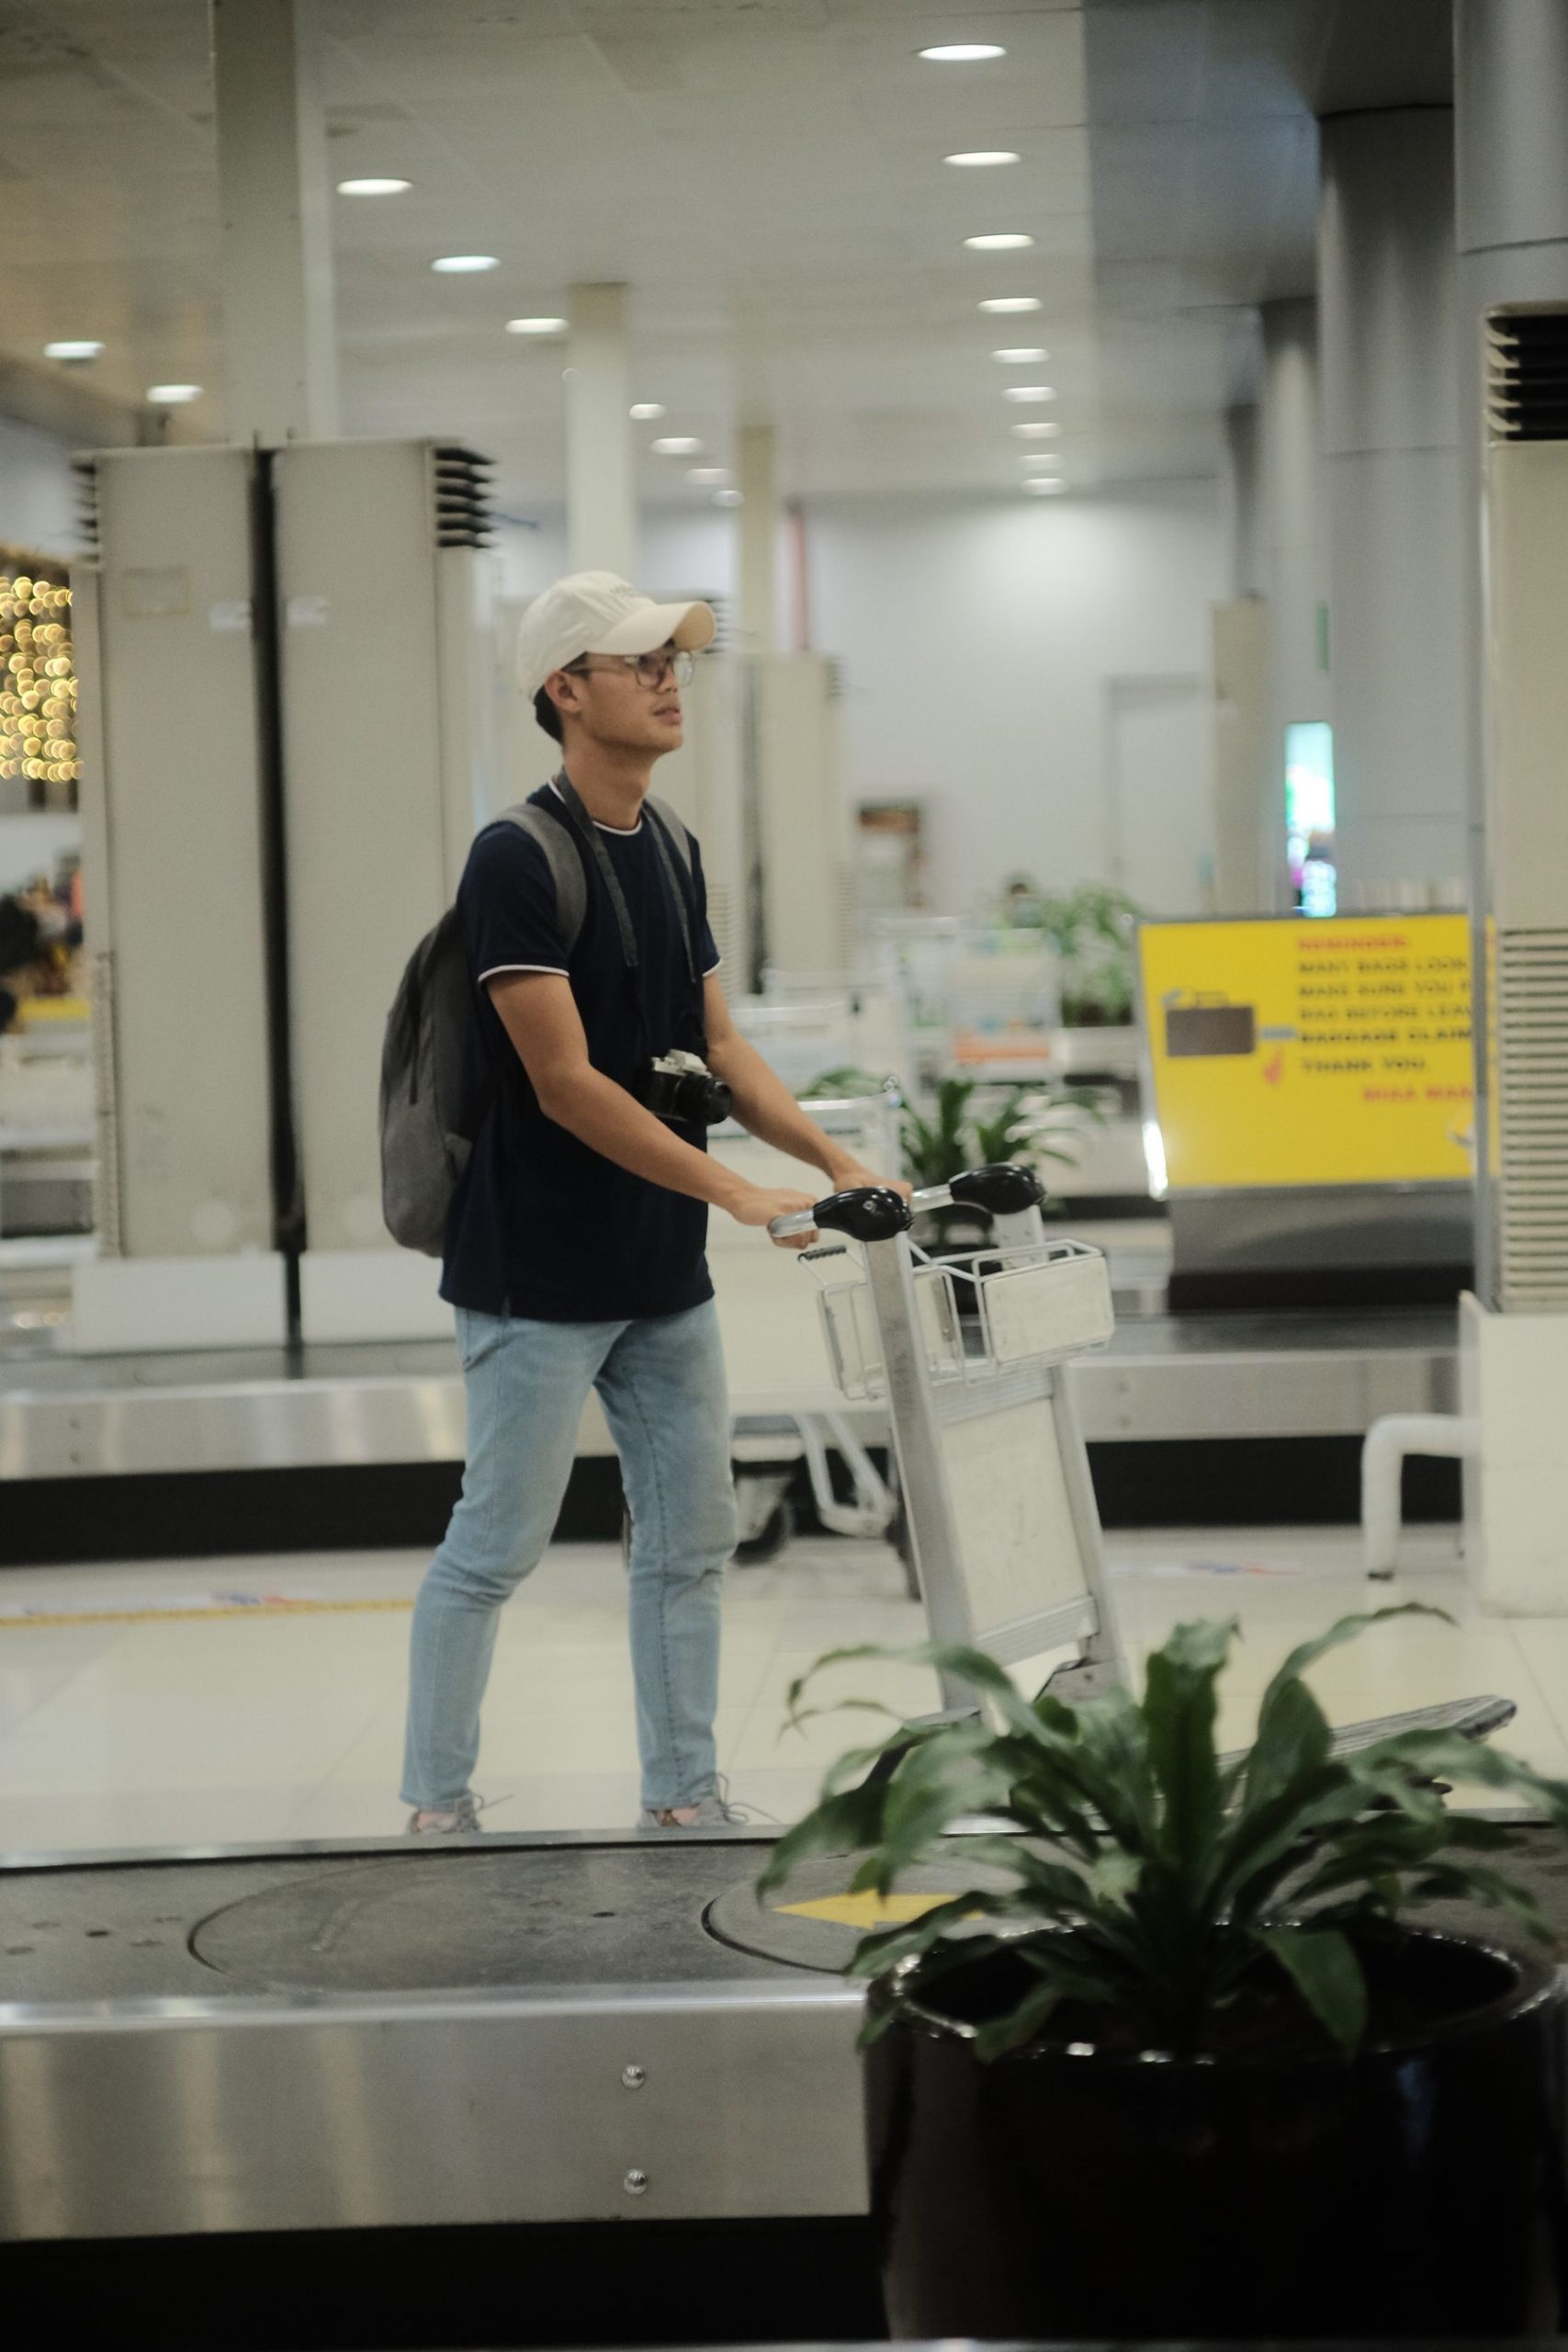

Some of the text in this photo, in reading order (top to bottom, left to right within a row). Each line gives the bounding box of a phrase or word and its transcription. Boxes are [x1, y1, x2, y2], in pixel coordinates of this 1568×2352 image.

[1356, 959, 1410, 974] BAGS
[1297, 984, 1350, 999] MAKE
[1356, 982, 1407, 998] SURE
[1298, 1007, 1337, 1022] BAG
[1343, 1005, 1420, 1021] BEFORE
[1298, 1030, 1399, 1046] BAGGAGE
[1300, 1057, 1372, 1074] THANK
